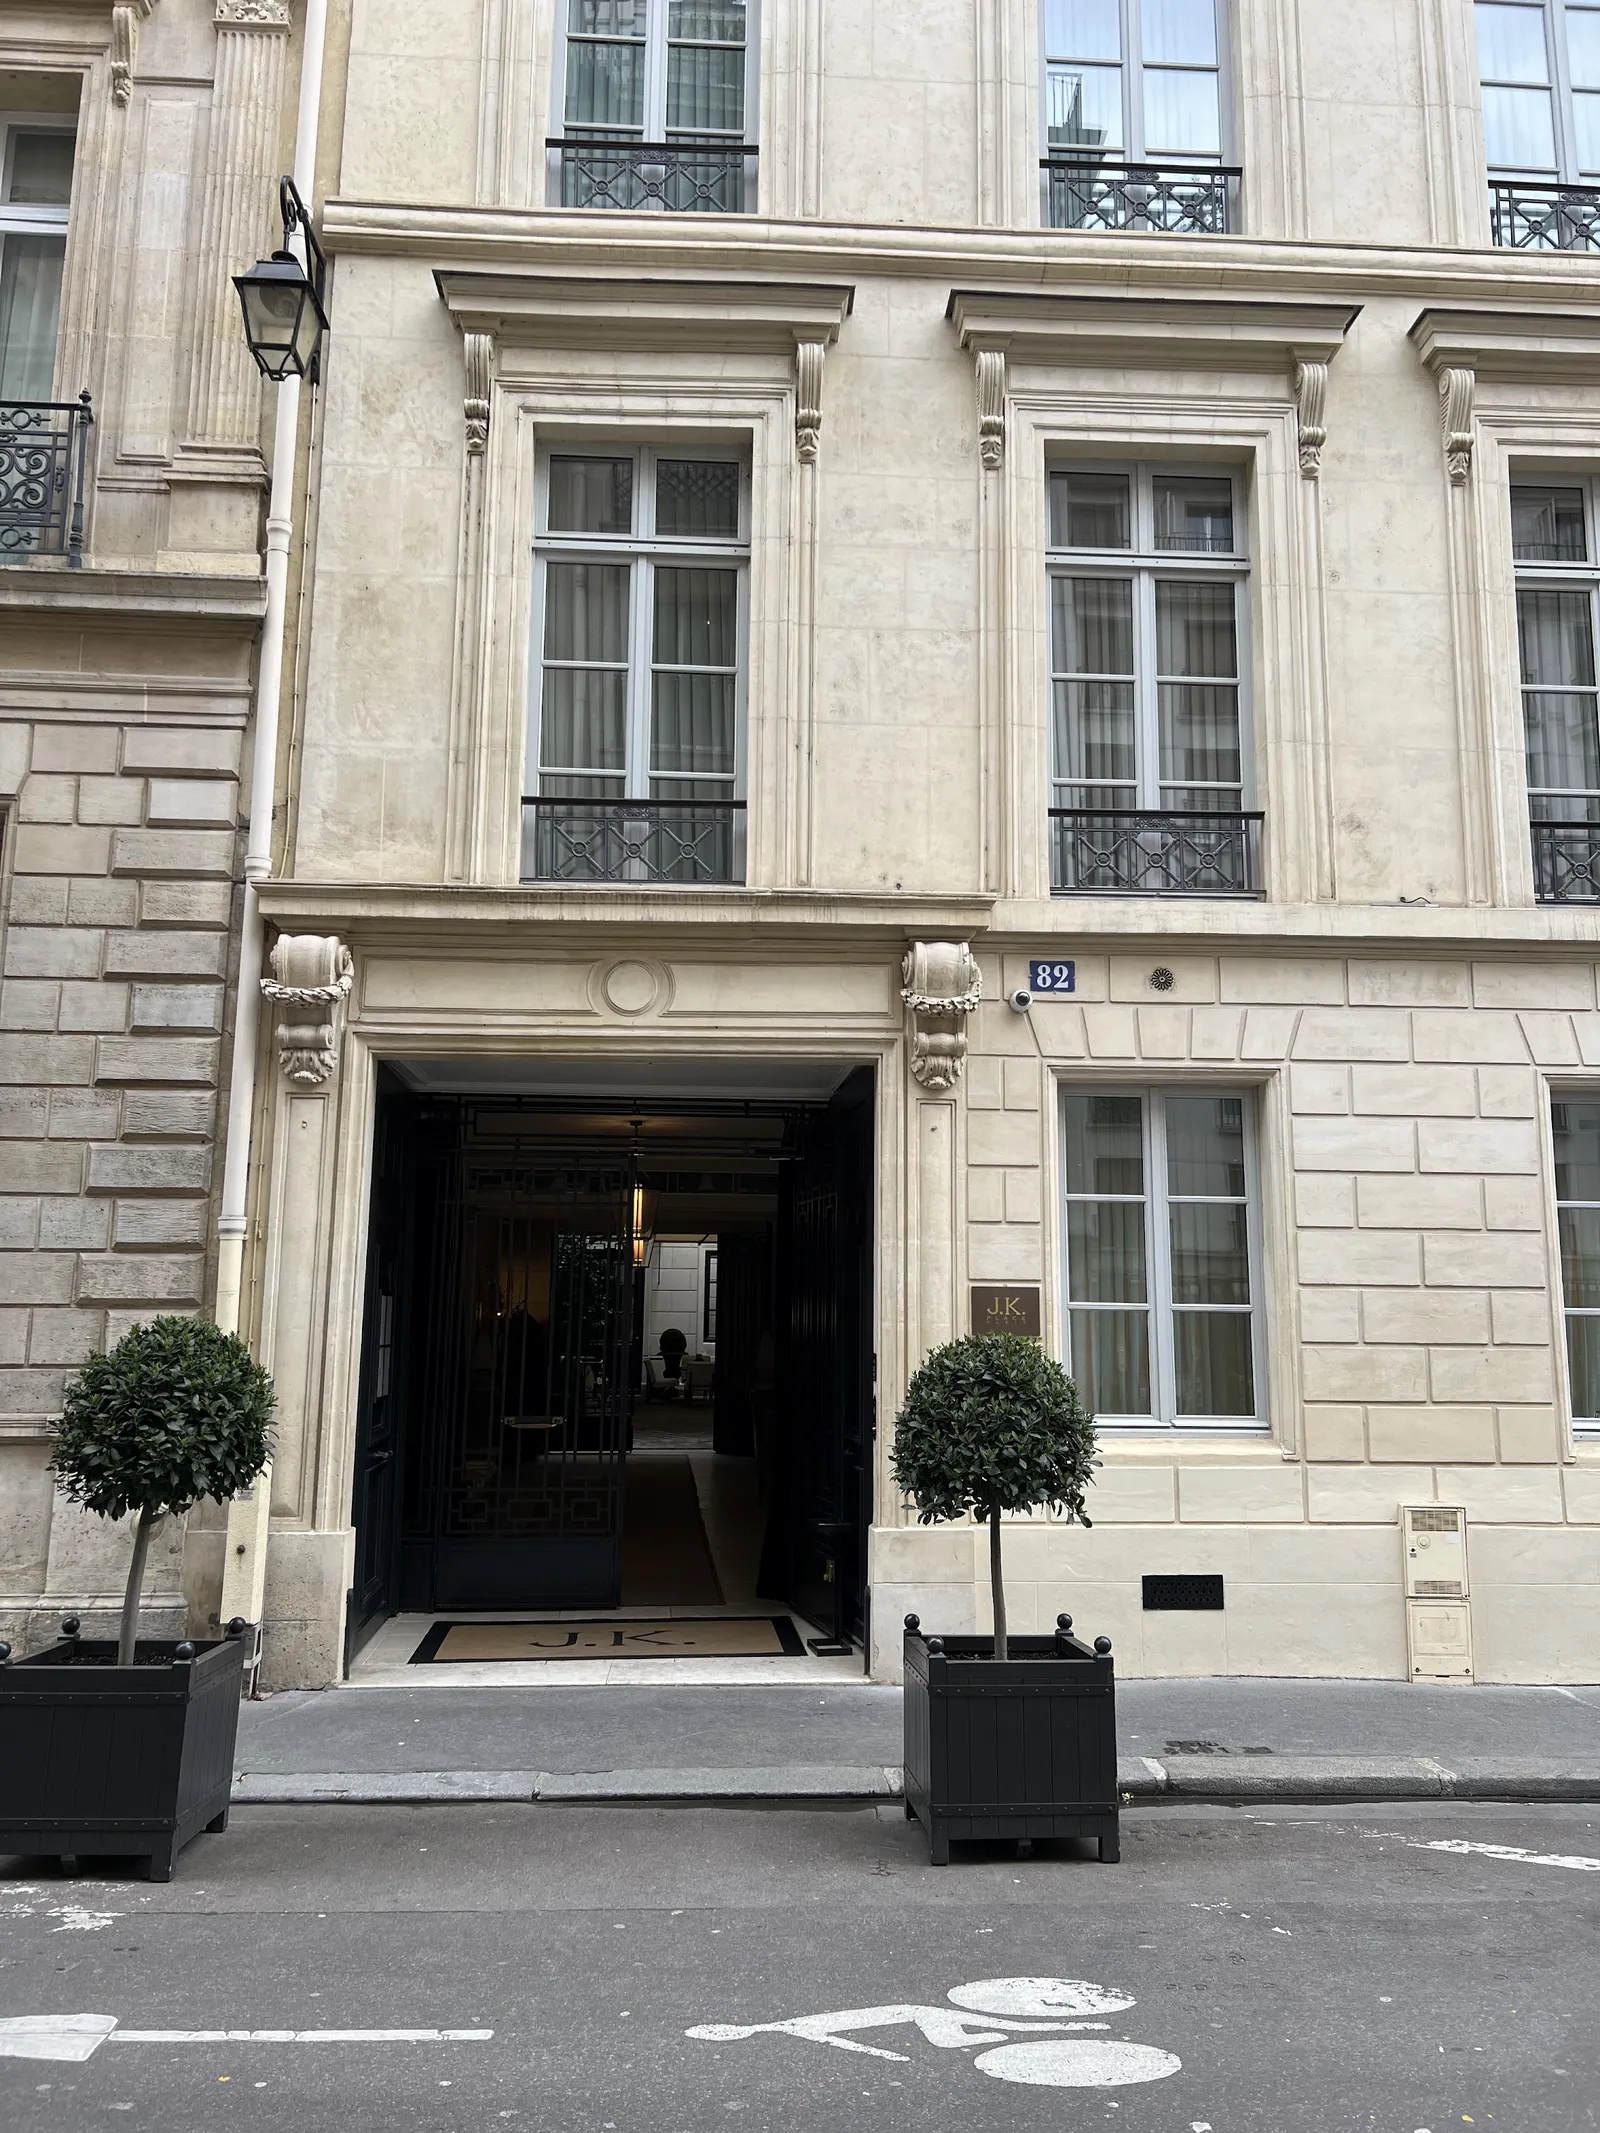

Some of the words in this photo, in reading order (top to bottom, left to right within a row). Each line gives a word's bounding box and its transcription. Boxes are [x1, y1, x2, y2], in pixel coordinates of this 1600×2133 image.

[1036, 964, 1069, 988] 82
[987, 1297, 1026, 1315] J.K.
[529, 1630, 696, 1648] J.K.
